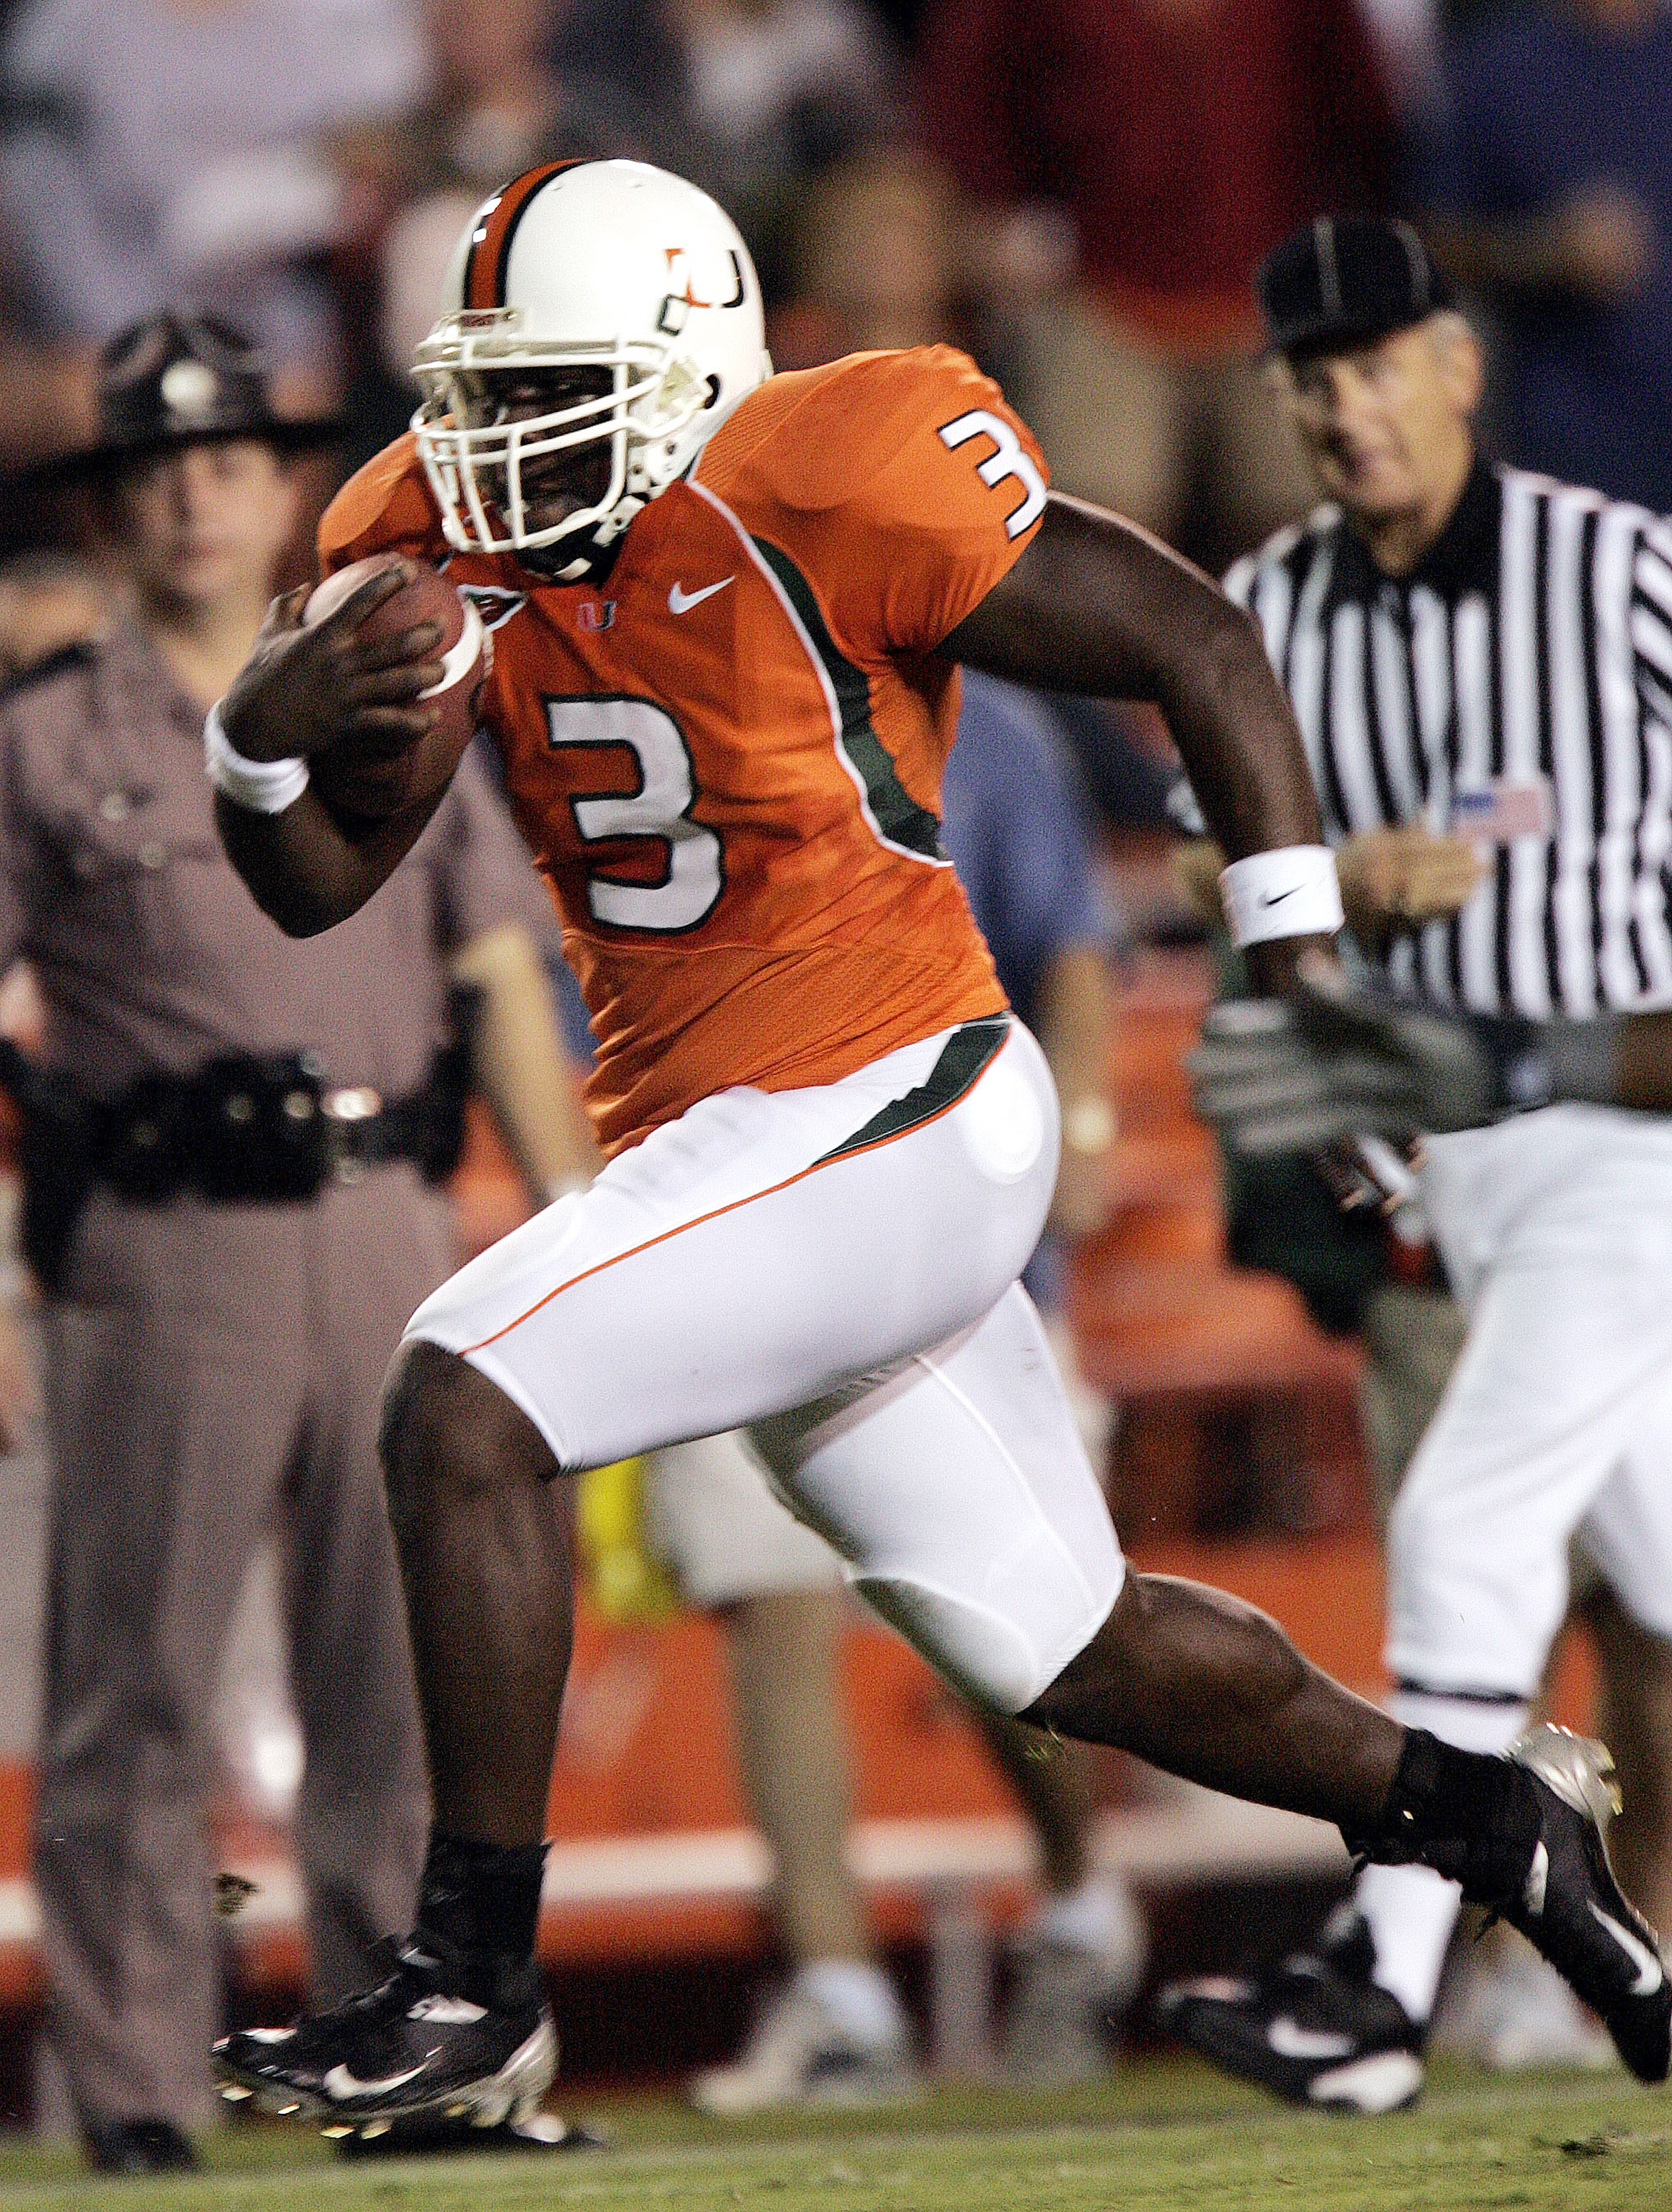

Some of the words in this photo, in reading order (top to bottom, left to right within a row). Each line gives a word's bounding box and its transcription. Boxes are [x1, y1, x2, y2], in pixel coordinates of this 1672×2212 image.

[937, 408, 1047, 541] 3
[576, 595, 617, 632] U
[544, 695, 724, 933] 3
